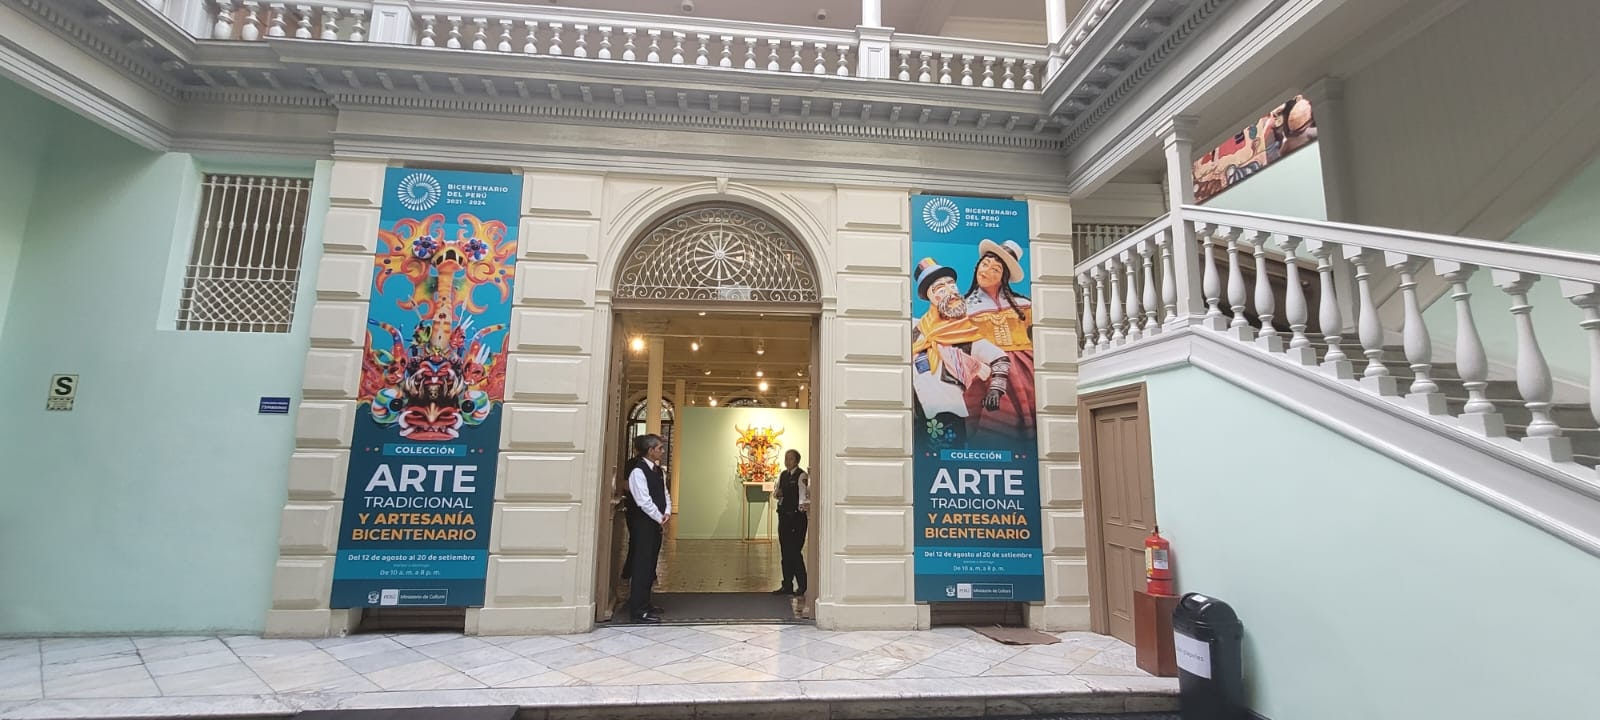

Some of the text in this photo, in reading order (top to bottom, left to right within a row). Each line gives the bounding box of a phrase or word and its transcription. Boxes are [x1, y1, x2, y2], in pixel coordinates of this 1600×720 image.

[448, 184, 508, 193] BICENTENARIO
[965, 208, 1017, 216] BICENTENARIO
[54, 376, 72, 395] S
[395, 446, 455, 454] COLECCIÓN
[950, 451, 1002, 460] COLECCIÓN
[364, 464, 478, 493] ARTE
[929, 468, 1025, 495] ARTE
[364, 496, 473, 508] TRADICIONAL
[930, 498, 1024, 510] TRADICIONAL
[359, 510, 474, 525] Y ARTESANÍA
[928, 512, 1027, 525] Y ARTESANÍA
[352, 528, 476, 540] BICENTENARIO
[925, 528, 1030, 540] BICENTENARIO
